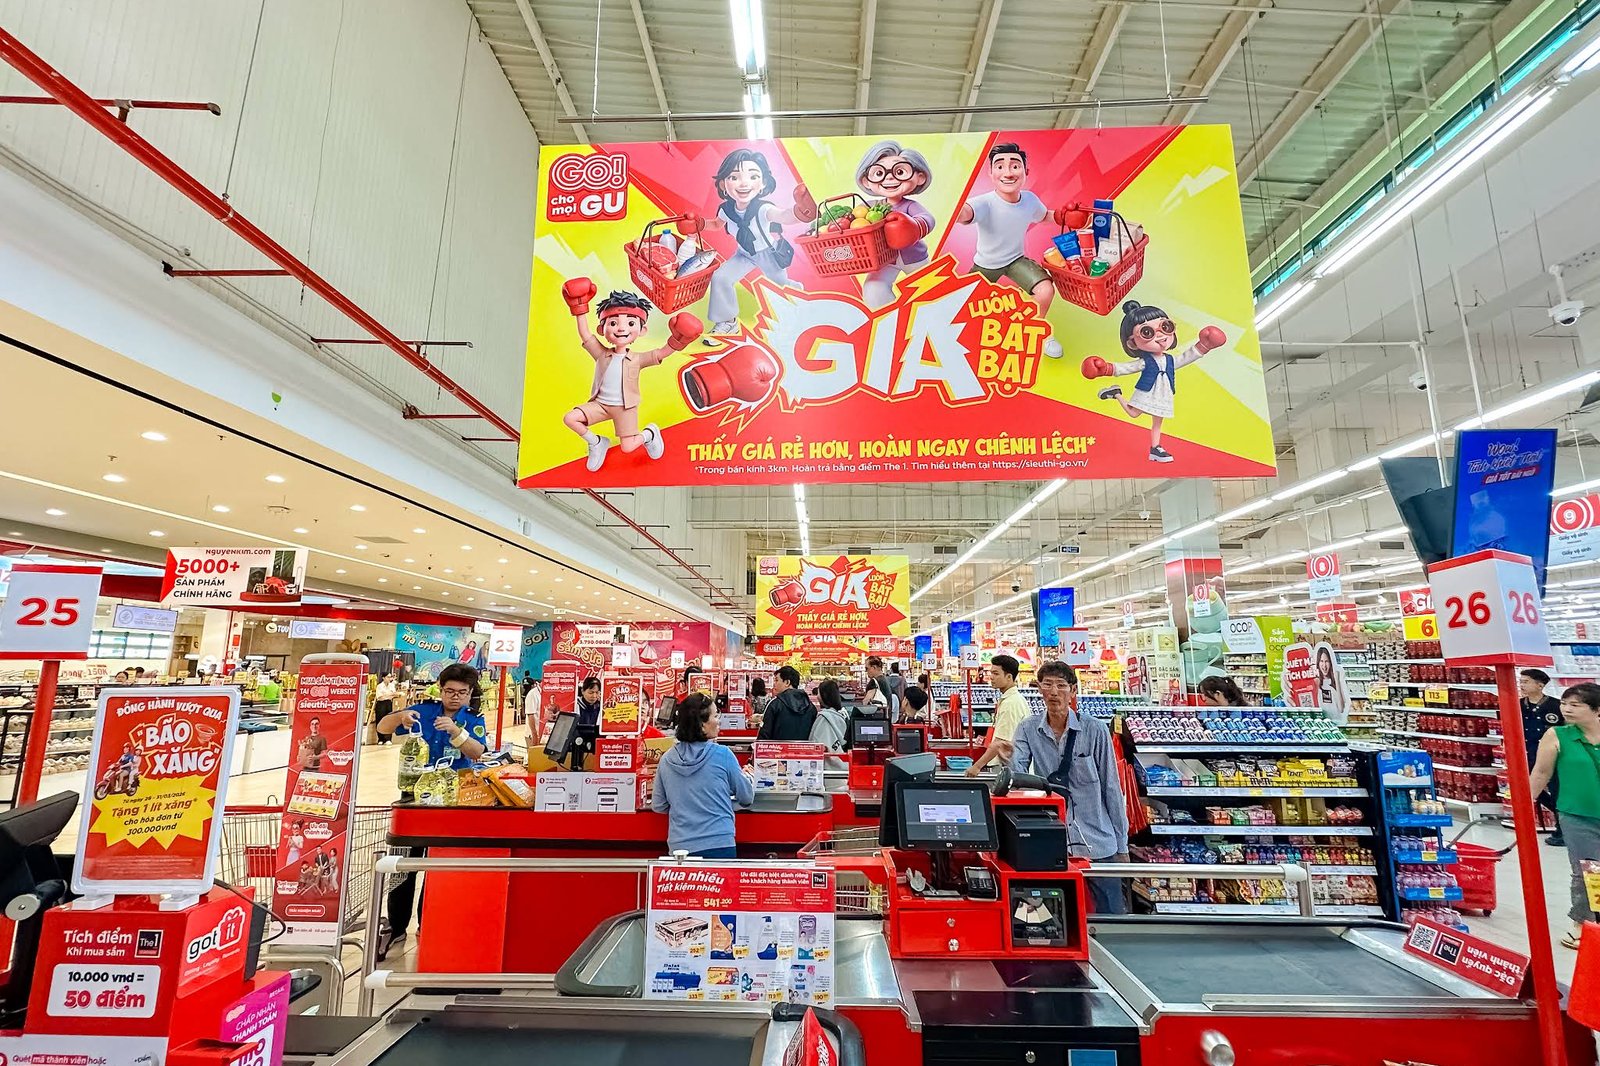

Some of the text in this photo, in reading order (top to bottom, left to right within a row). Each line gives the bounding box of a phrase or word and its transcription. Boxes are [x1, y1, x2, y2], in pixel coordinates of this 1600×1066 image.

[551, 154, 629, 191] GO!
[550, 194, 575, 205] cho
[551, 191, 625, 217] mọi GU
[968, 292, 1017, 318] LUÔN
[759, 261, 986, 406] GIÁ
[980, 306, 1046, 354] BẤT
[977, 350, 1036, 391] BẠI
[687, 433, 737, 461] THẤY
[742, 436, 776, 460] GIÁ
[781, 435, 804, 460] RẺ
[809, 440, 853, 461] HƠN,
[859, 434, 911, 458] HOÀN
[917, 438, 970, 456] NGAY
[975, 431, 1036, 456] CHÊNH
[727, 464, 744, 473] bán
[746, 464, 765, 473] kính
[768, 464, 789, 473] 3km.
[792, 463, 815, 472] Hoàn
[858, 461, 880, 471] điểm
[883, 461, 900, 471] The
[911, 461, 928, 470] Tìm
[930, 459, 950, 469] hiểu
[952, 461, 976, 470] thêm
[978, 461, 990, 471] tại
[1564, 508, 1576, 524] 9
[177, 558, 240, 574] 5000+
[176, 576, 225, 588] SẢN PHẨM
[801, 559, 874, 609] GIÁ
[870, 581, 893, 595] BẤT
[173, 588, 203, 598] CHÍNH
[868, 592, 889, 608] BẠI
[16, 597, 79, 626] 25
[1445, 591, 1491, 629] 26
[1508, 590, 1539, 626] 26
[797, 612, 818, 622] THẤY
[820, 612, 835, 622] GIÁ
[1230, 622, 1252, 634] OCOP
[1272, 628, 1286, 636] Sản
[1420, 619, 1434, 637] 6
[495, 640, 515, 652] 23
[524, 630, 549, 646] GO!
[966, 652, 977, 661] 22
[1070, 642, 1086, 654] 24
[116, 697, 224, 720] ĐỒNG HÀNH VƯỢT QUA
[300, 700, 354, 711] sieuthi-go.vn
[112, 804, 139, 819] Tặng
[143, 804, 148, 814] 1
[150, 802, 162, 813] lít
[124, 816, 140, 826] cho
[142, 814, 154, 823] hóa
[156, 813, 172, 822] đơn
[658, 869, 724, 884] Mua nhiều
[656, 882, 721, 894] Tiết kiệm nhiều
[64, 926, 132, 944] Tích điểm
[226, 922, 236, 940] it
[66, 947, 126, 957] Khi mua sắm
[190, 930, 217, 960] got
[1466, 946, 1521, 974] thành viên
[68, 971, 109, 982] 10.000
[112, 972, 134, 983] vnd
[1461, 956, 1516, 986] Đặc quyền
[64, 985, 146, 1009] 50 điểm
[232, 1010, 278, 1042] THANH TOÁN
[236, 1012, 256, 1031] CHẤP
